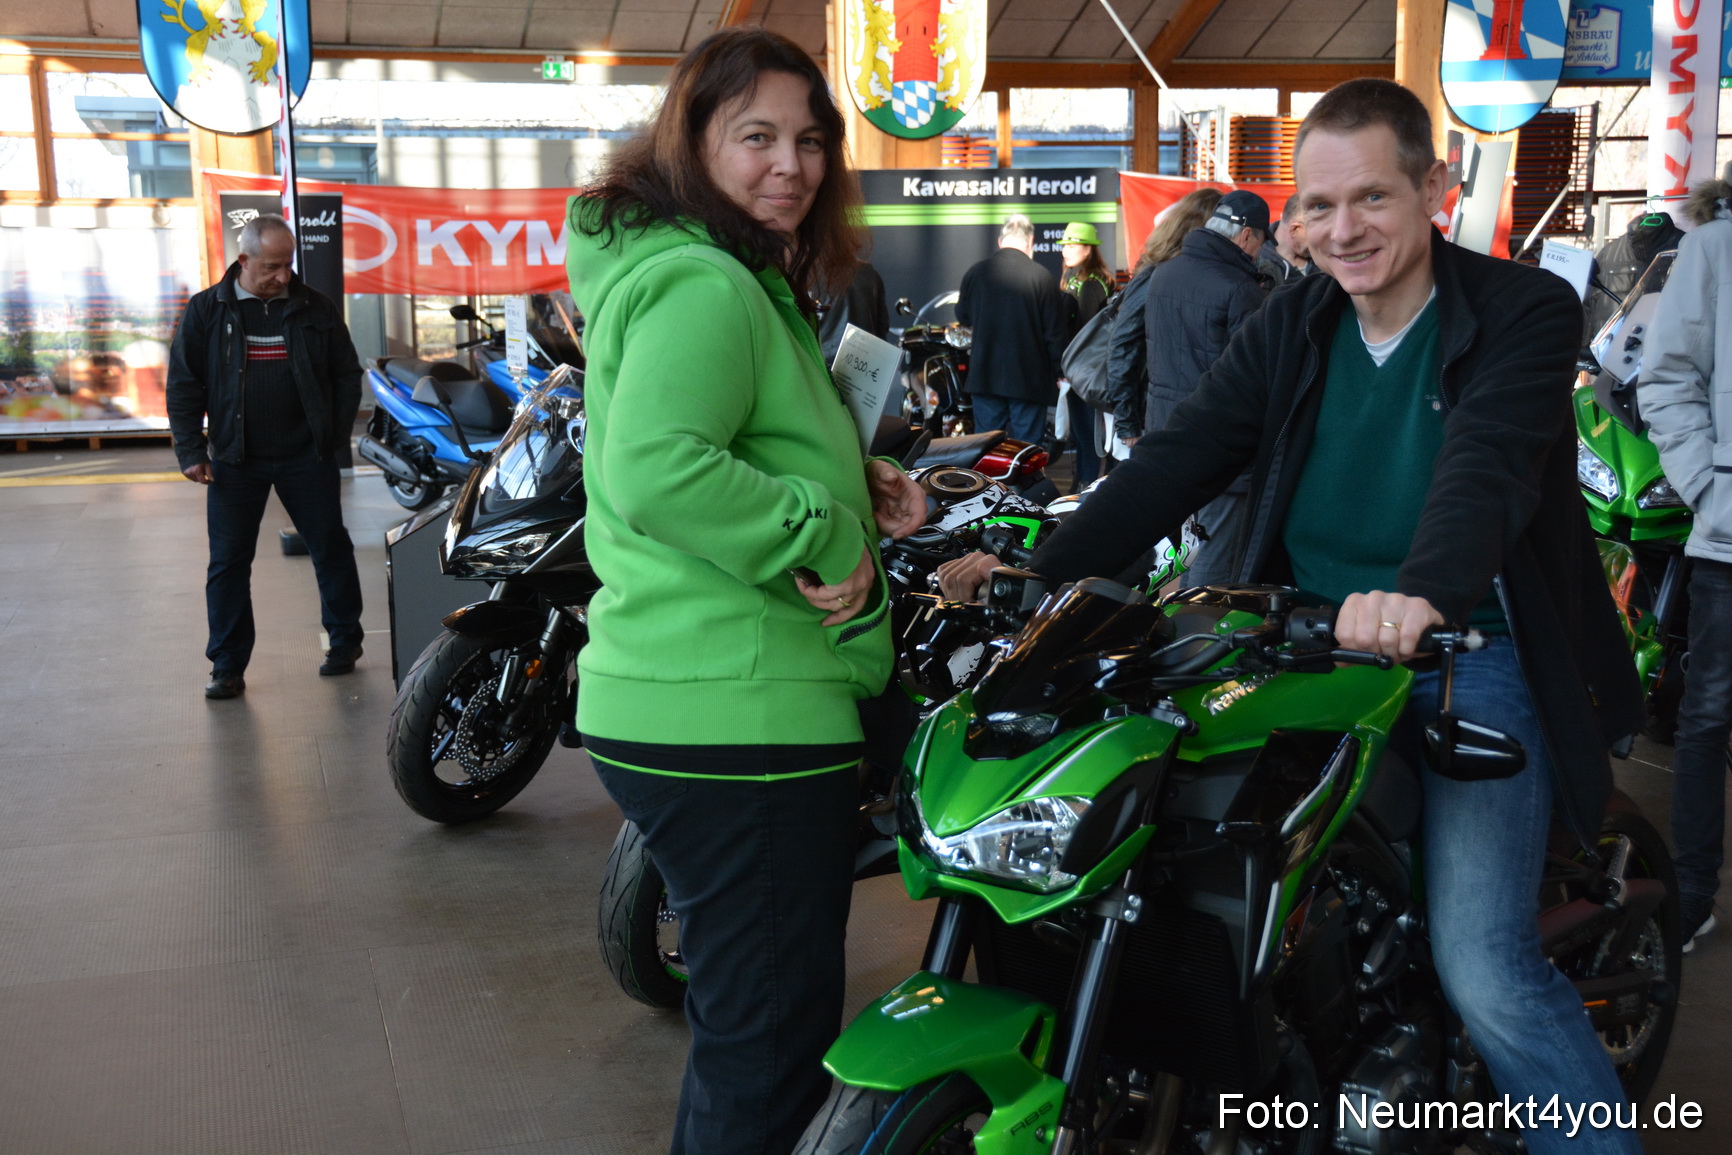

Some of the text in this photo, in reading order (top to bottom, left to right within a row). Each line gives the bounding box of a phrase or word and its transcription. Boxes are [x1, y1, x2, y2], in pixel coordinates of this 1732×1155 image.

[903, 176, 1097, 197] Kawasaki Herold
[1010, 1101, 1054, 1136] ABS
